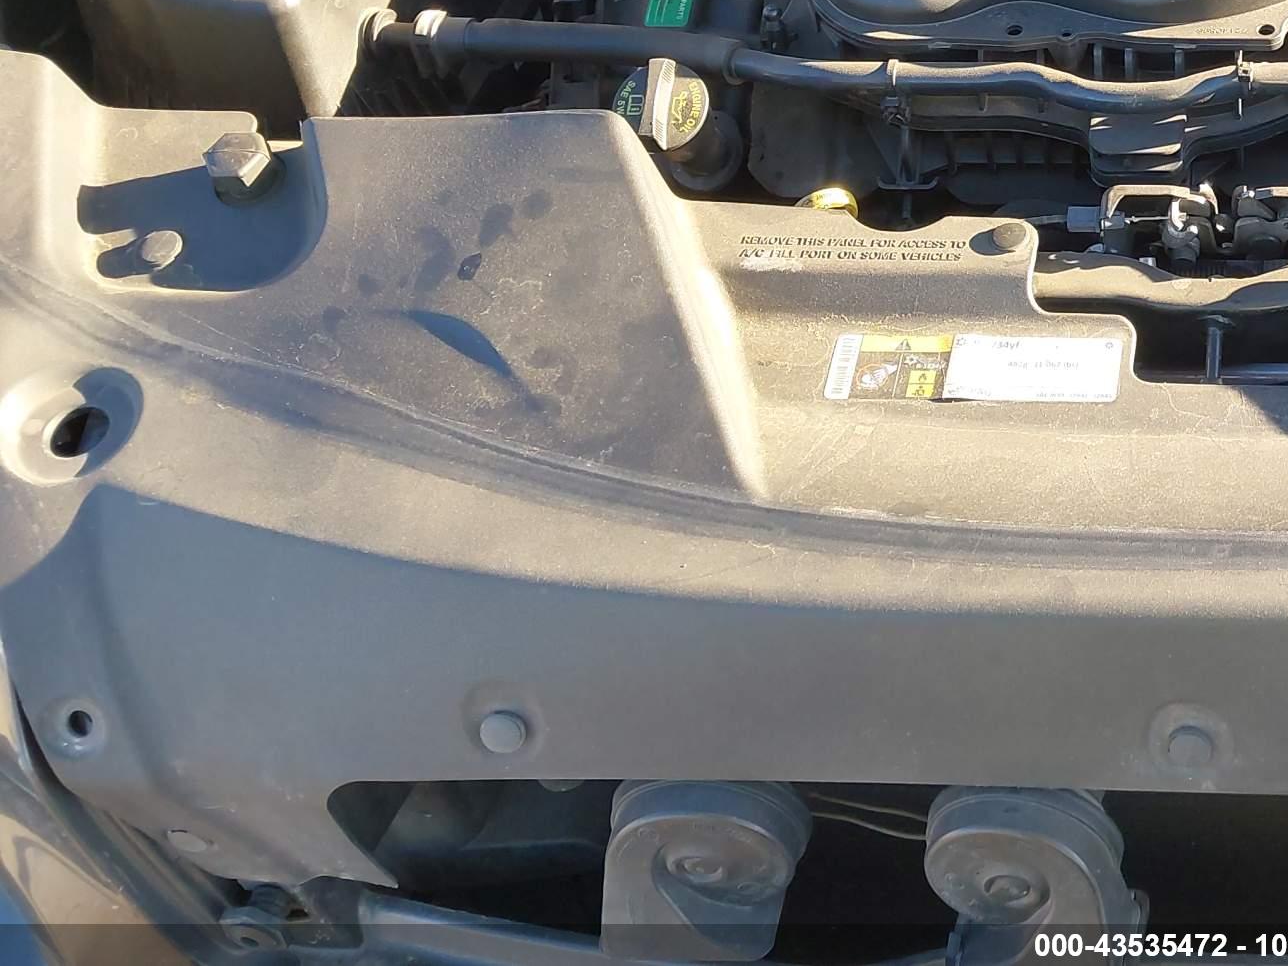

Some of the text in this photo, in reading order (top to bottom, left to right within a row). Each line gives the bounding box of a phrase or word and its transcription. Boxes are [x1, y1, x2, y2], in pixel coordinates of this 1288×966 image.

[621, 80, 636, 98] SAE
[680, 81, 702, 133] ENGINE OIL
[740, 235, 967, 249] REMOVE THIS PANEL FOR ACCESS TO
[738, 248, 962, 262] A/C FILL PORT ON SOME VEHICLES
